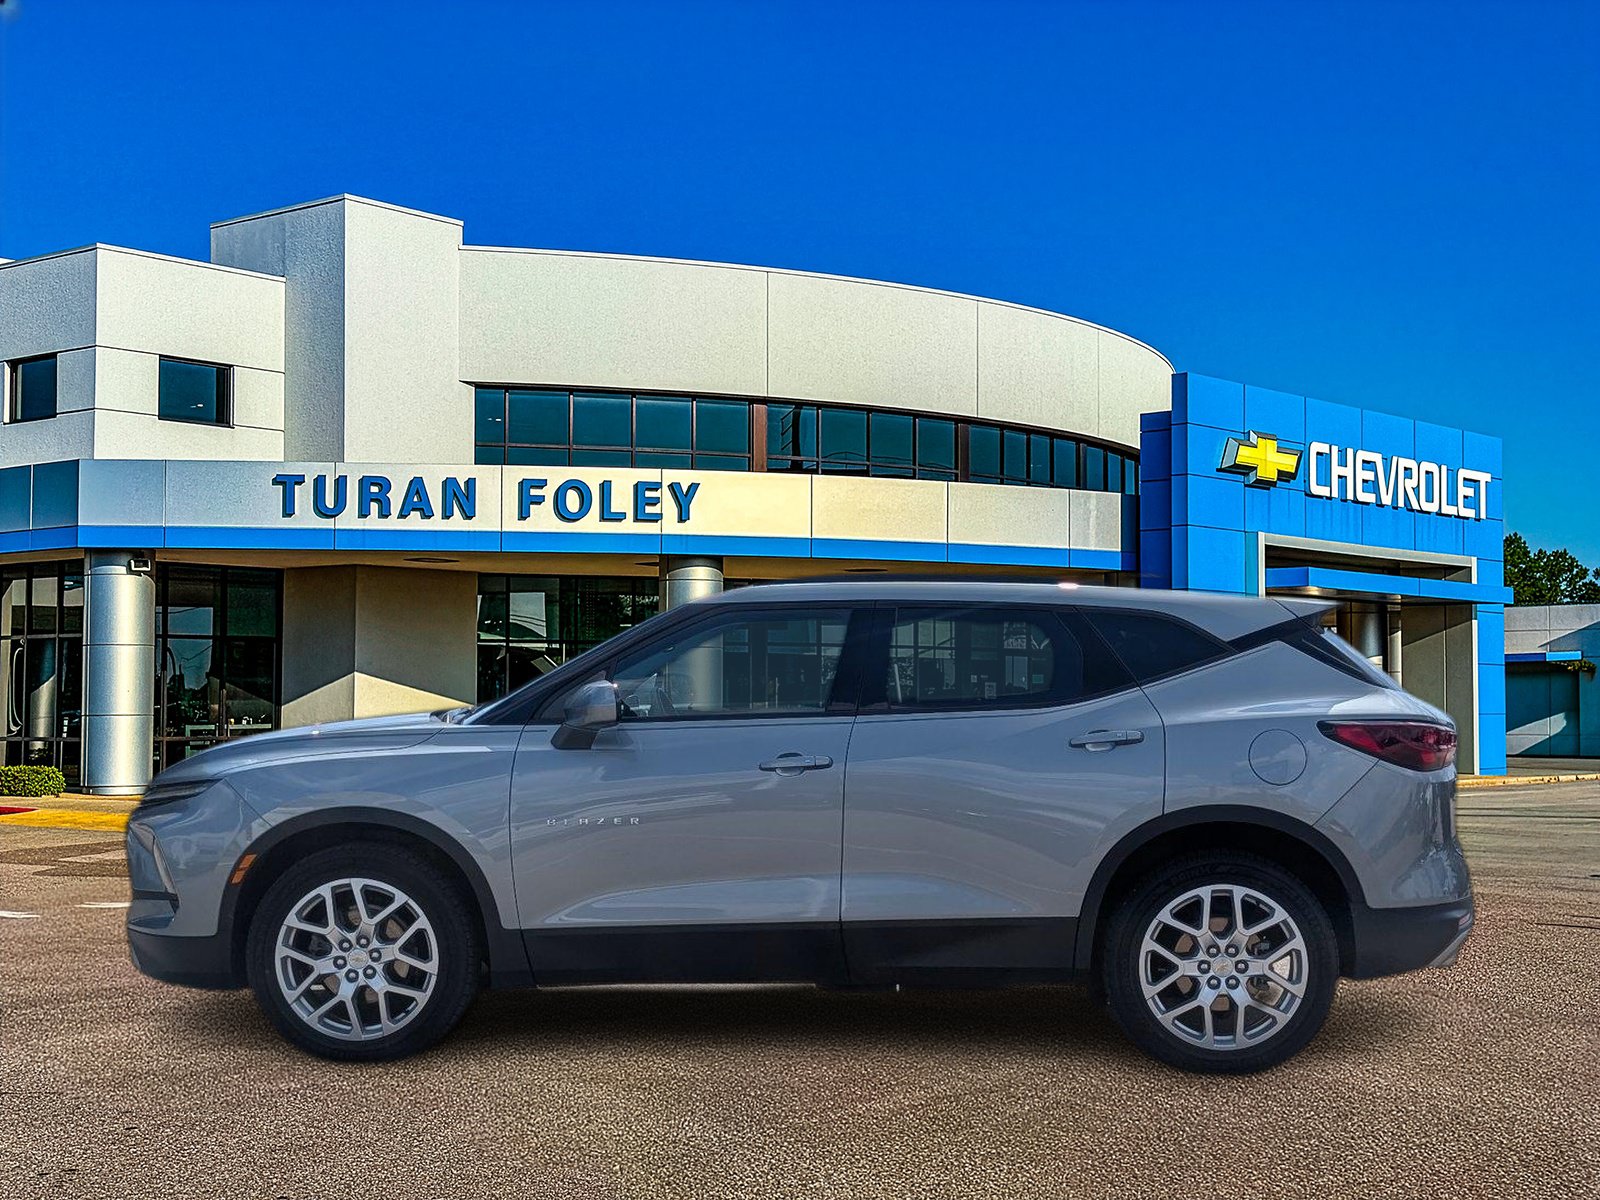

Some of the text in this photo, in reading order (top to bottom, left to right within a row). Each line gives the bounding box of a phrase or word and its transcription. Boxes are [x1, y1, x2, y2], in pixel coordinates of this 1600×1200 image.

[272, 474, 701, 523] TURAN FOLEY
[1308, 441, 1492, 520] CHEVROLET
[546, 817, 641, 826] BLAZER
